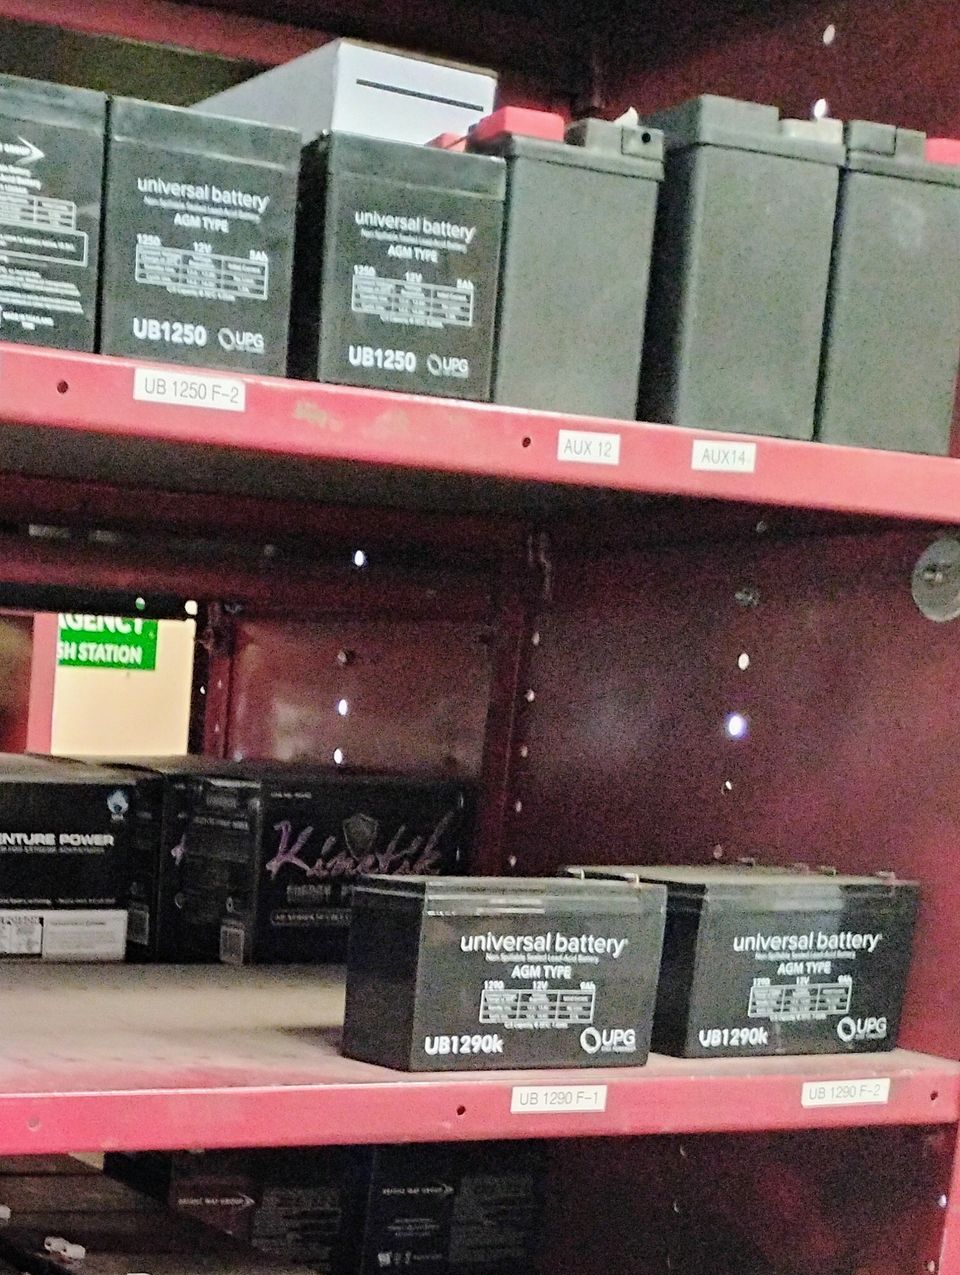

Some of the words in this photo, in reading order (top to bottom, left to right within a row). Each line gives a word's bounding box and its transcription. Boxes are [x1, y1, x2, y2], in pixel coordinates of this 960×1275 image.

[137, 177, 209, 200] universal
[212, 185, 270, 214] battery
[174, 213, 201, 228] AGM
[355, 211, 420, 232] universal
[423, 217, 476, 244] battery
[387, 244, 413, 259] AGM
[133, 317, 207, 347] UB1250
[349, 345, 416, 373] UB1250
[145, 377, 166, 395] UB
[173, 380, 207, 400] 1250
[212, 384, 239, 404] F-2
[564, 438, 592, 457] AUX
[599, 441, 613, 458] 12
[701, 448, 746, 466] AUX14
[58, 613, 143, 635] GENC
[78, 642, 143, 665] STATION
[59, 833, 115, 847] POWER
[460, 931, 552, 953] universal
[555, 932, 625, 959] battery
[733, 932, 815, 952] universal
[817, 931, 879, 953] battery
[511, 965, 541, 979] AGM
[543, 965, 572, 979] TYPE
[777, 962, 804, 976] AGM
[806, 961, 832, 974] TYPE
[424, 1033, 504, 1056] UB1290k
[601, 1029, 636, 1046] UPG
[698, 1027, 768, 1048] UB1290k
[855, 1017, 887, 1033] UPG
[520, 1092, 539, 1106] UB
[543, 1091, 573, 1105] 1290
[576, 1091, 598, 1105] F-1
[809, 1087, 826, 1100] UB
[831, 1085, 857, 1099] 1290
[859, 1083, 881, 1097] F-2
